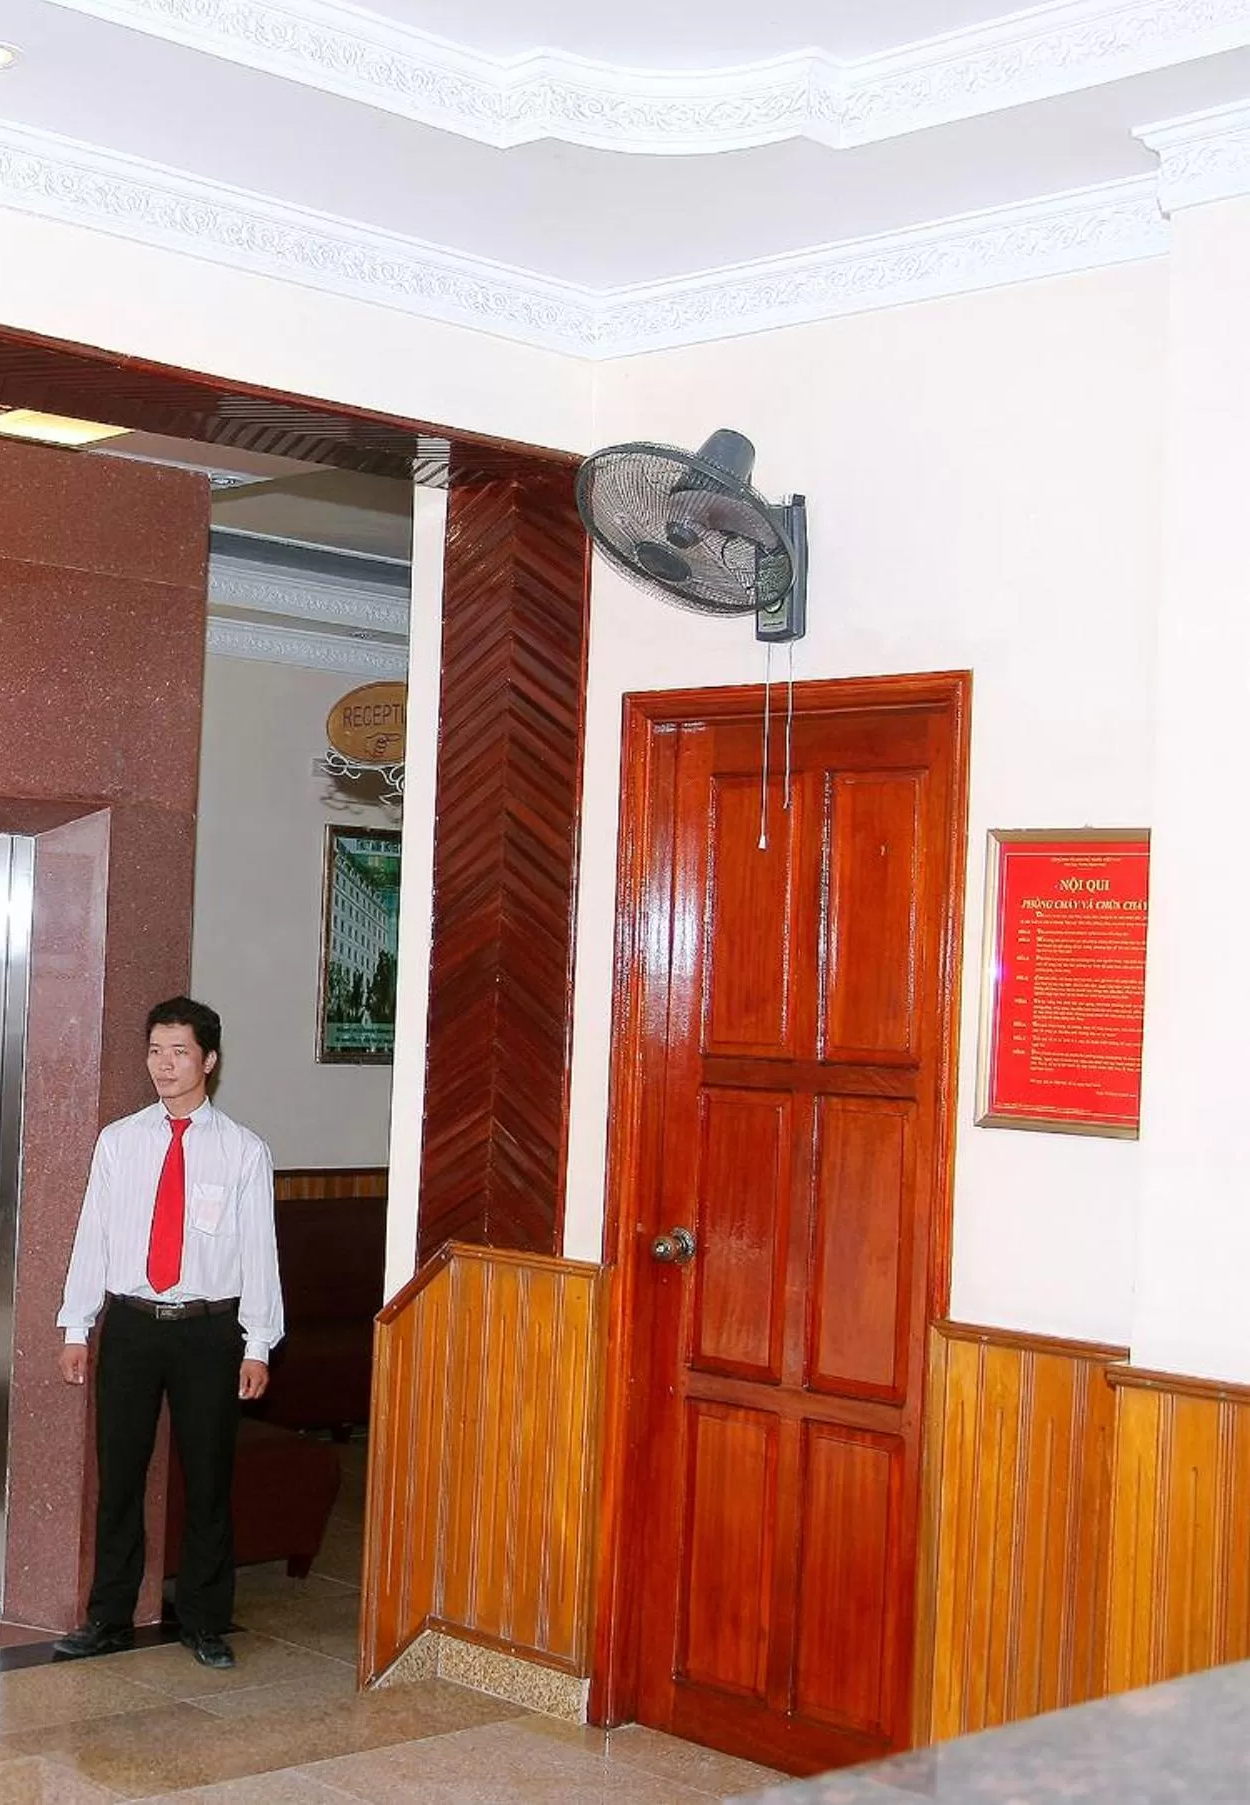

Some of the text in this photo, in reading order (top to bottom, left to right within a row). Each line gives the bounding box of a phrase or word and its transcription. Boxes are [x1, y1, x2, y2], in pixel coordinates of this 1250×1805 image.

[343, 704, 404, 728] RECEPTI
[1060, 876, 1110, 893] NỘI QUI
